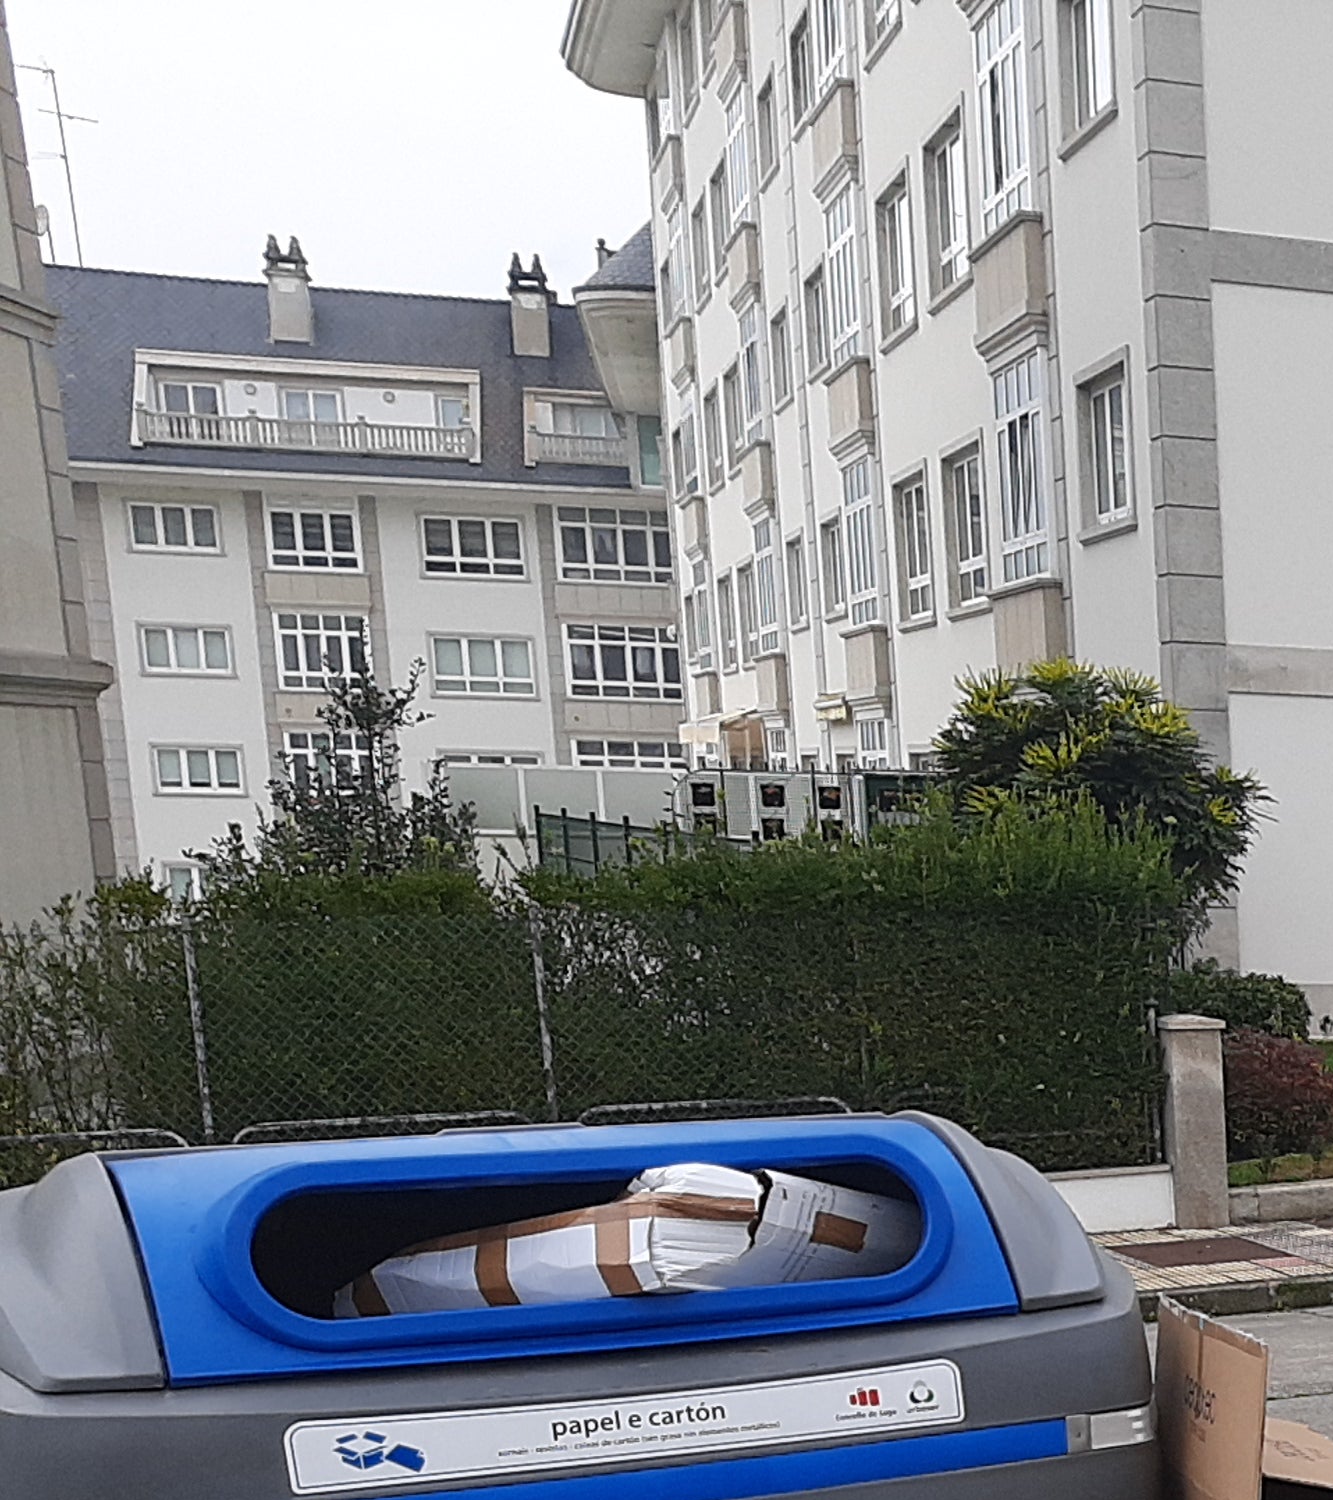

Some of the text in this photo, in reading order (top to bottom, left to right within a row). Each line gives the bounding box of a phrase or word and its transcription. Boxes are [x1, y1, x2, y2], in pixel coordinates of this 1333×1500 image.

[552, 1402, 726, 1441] papel e cartón
